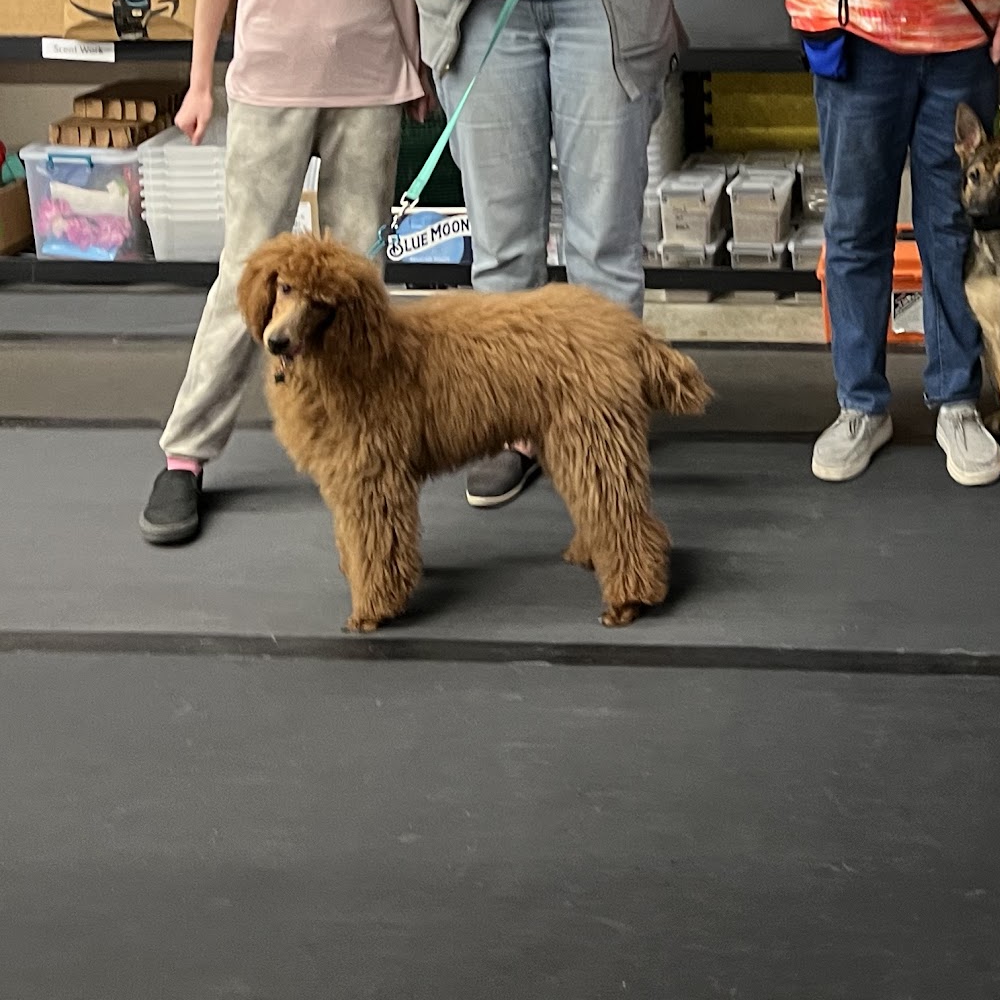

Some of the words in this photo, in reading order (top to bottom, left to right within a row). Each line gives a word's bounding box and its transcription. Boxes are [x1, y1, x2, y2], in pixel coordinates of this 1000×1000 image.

[54, 44, 77, 54] Scent
[80, 45, 104, 55] Work
[430, 218, 470, 242] MOON
